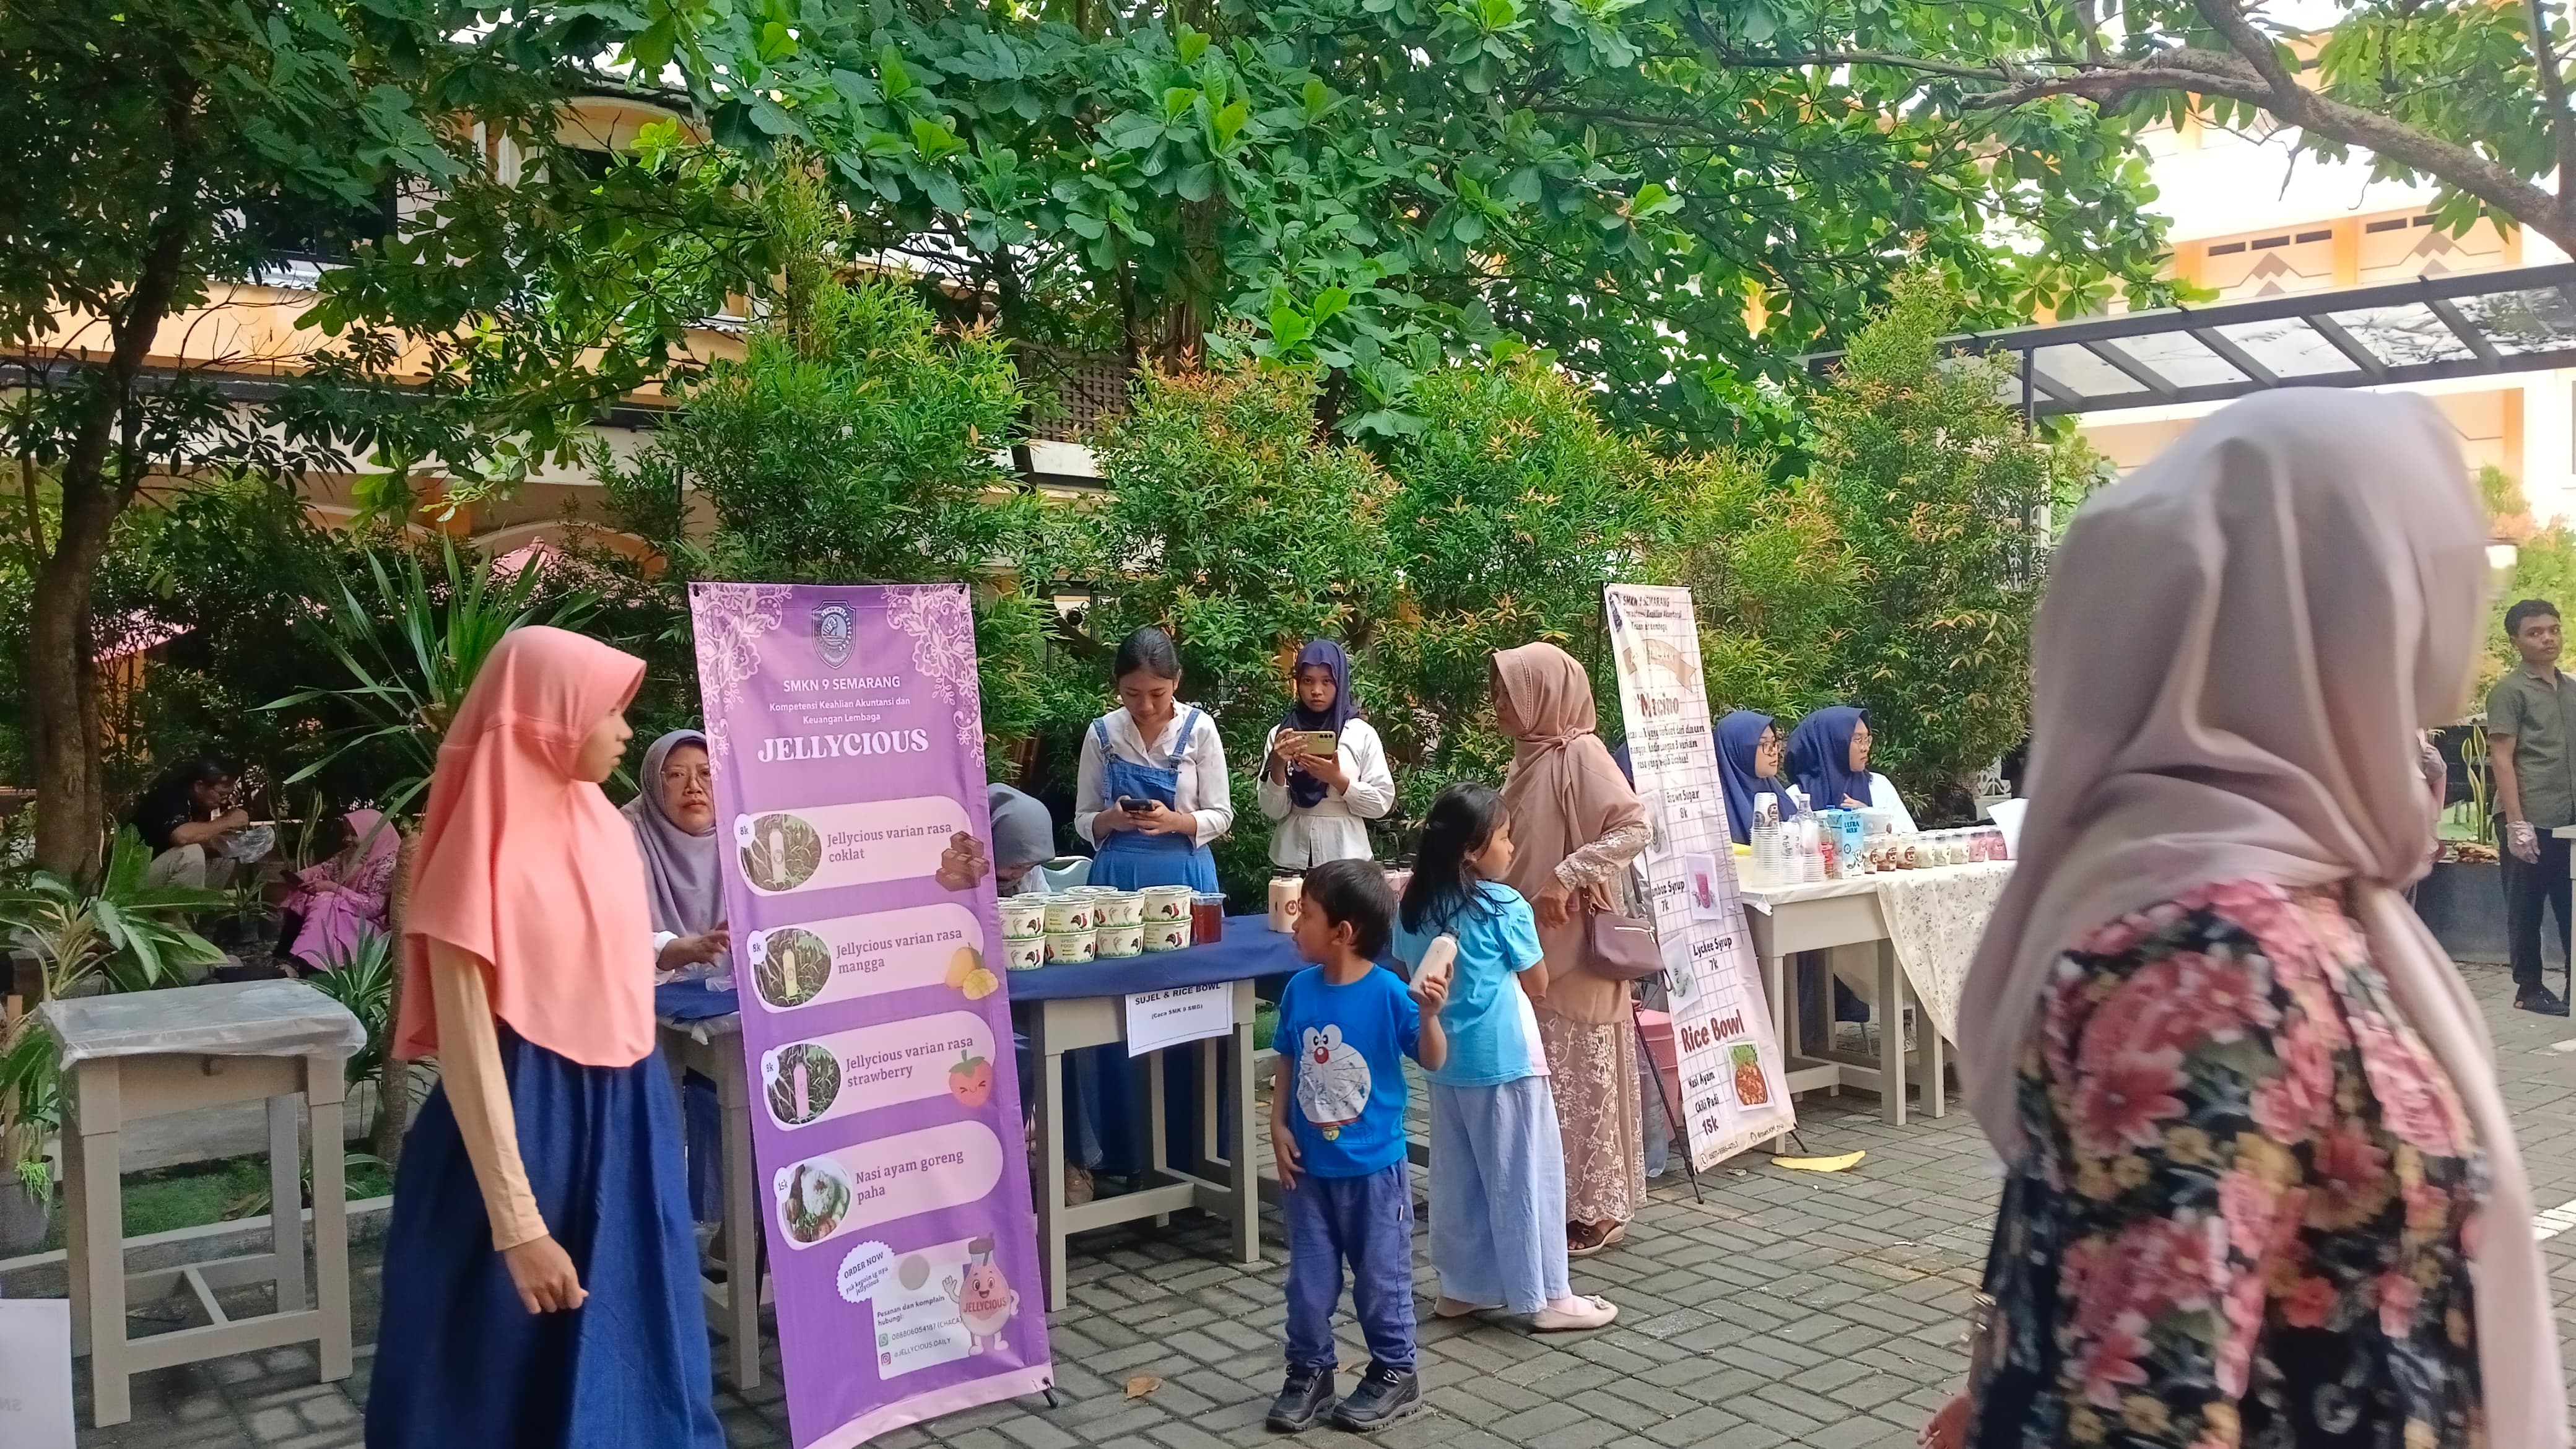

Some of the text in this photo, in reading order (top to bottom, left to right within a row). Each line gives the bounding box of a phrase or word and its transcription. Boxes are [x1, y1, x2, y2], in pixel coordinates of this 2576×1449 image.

[783, 676, 900, 692] SMKN 9 SEMARANG
[770, 697, 910, 712] Kompetensi Keahlian Akuntansi dan
[803, 713, 881, 725] Keuangan Lembaga
[1686, 724, 1705, 734] daun
[757, 728, 928, 762] JELLYCIOUS
[1682, 790, 1699, 803] Sugar
[1679, 807, 1688, 819] 8k
[740, 825, 749, 835] 8k
[827, 822, 953, 848] Jellycious varian rasa
[829, 847, 865, 863] coklat
[1668, 880, 1685, 894] Syrup
[1661, 899, 1669, 912] 7k
[752, 942, 762, 953] 8k
[837, 929, 962, 959] Jellycious varian rasa
[1692, 937, 1733, 958] Lychee Syrup
[838, 957, 886, 976] mangga
[1709, 957, 1719, 971] 7k
[1135, 983, 1221, 1006] SUJEL & RICE BOWL
[1681, 1009, 1746, 1053] Rice Bowl
[846, 1037, 973, 1073] Jellycious varian rasa
[847, 1064, 913, 1088] strawberry
[1699, 1071, 1715, 1086] Ayam
[1707, 1094, 1720, 1109] Padi
[1702, 1115, 1719, 1136] 15k
[856, 1151, 964, 1185] Nasi ayam goreng
[857, 1185, 886, 1205] paha
[844, 1251, 884, 1279] ORDER NOW
[856, 1279, 879, 1296] jellycious
[877, 1307, 901, 1318] Pesanan
[915, 1295, 945, 1308] komplain
[964, 1297, 1007, 1313] JELLYCIOUS
